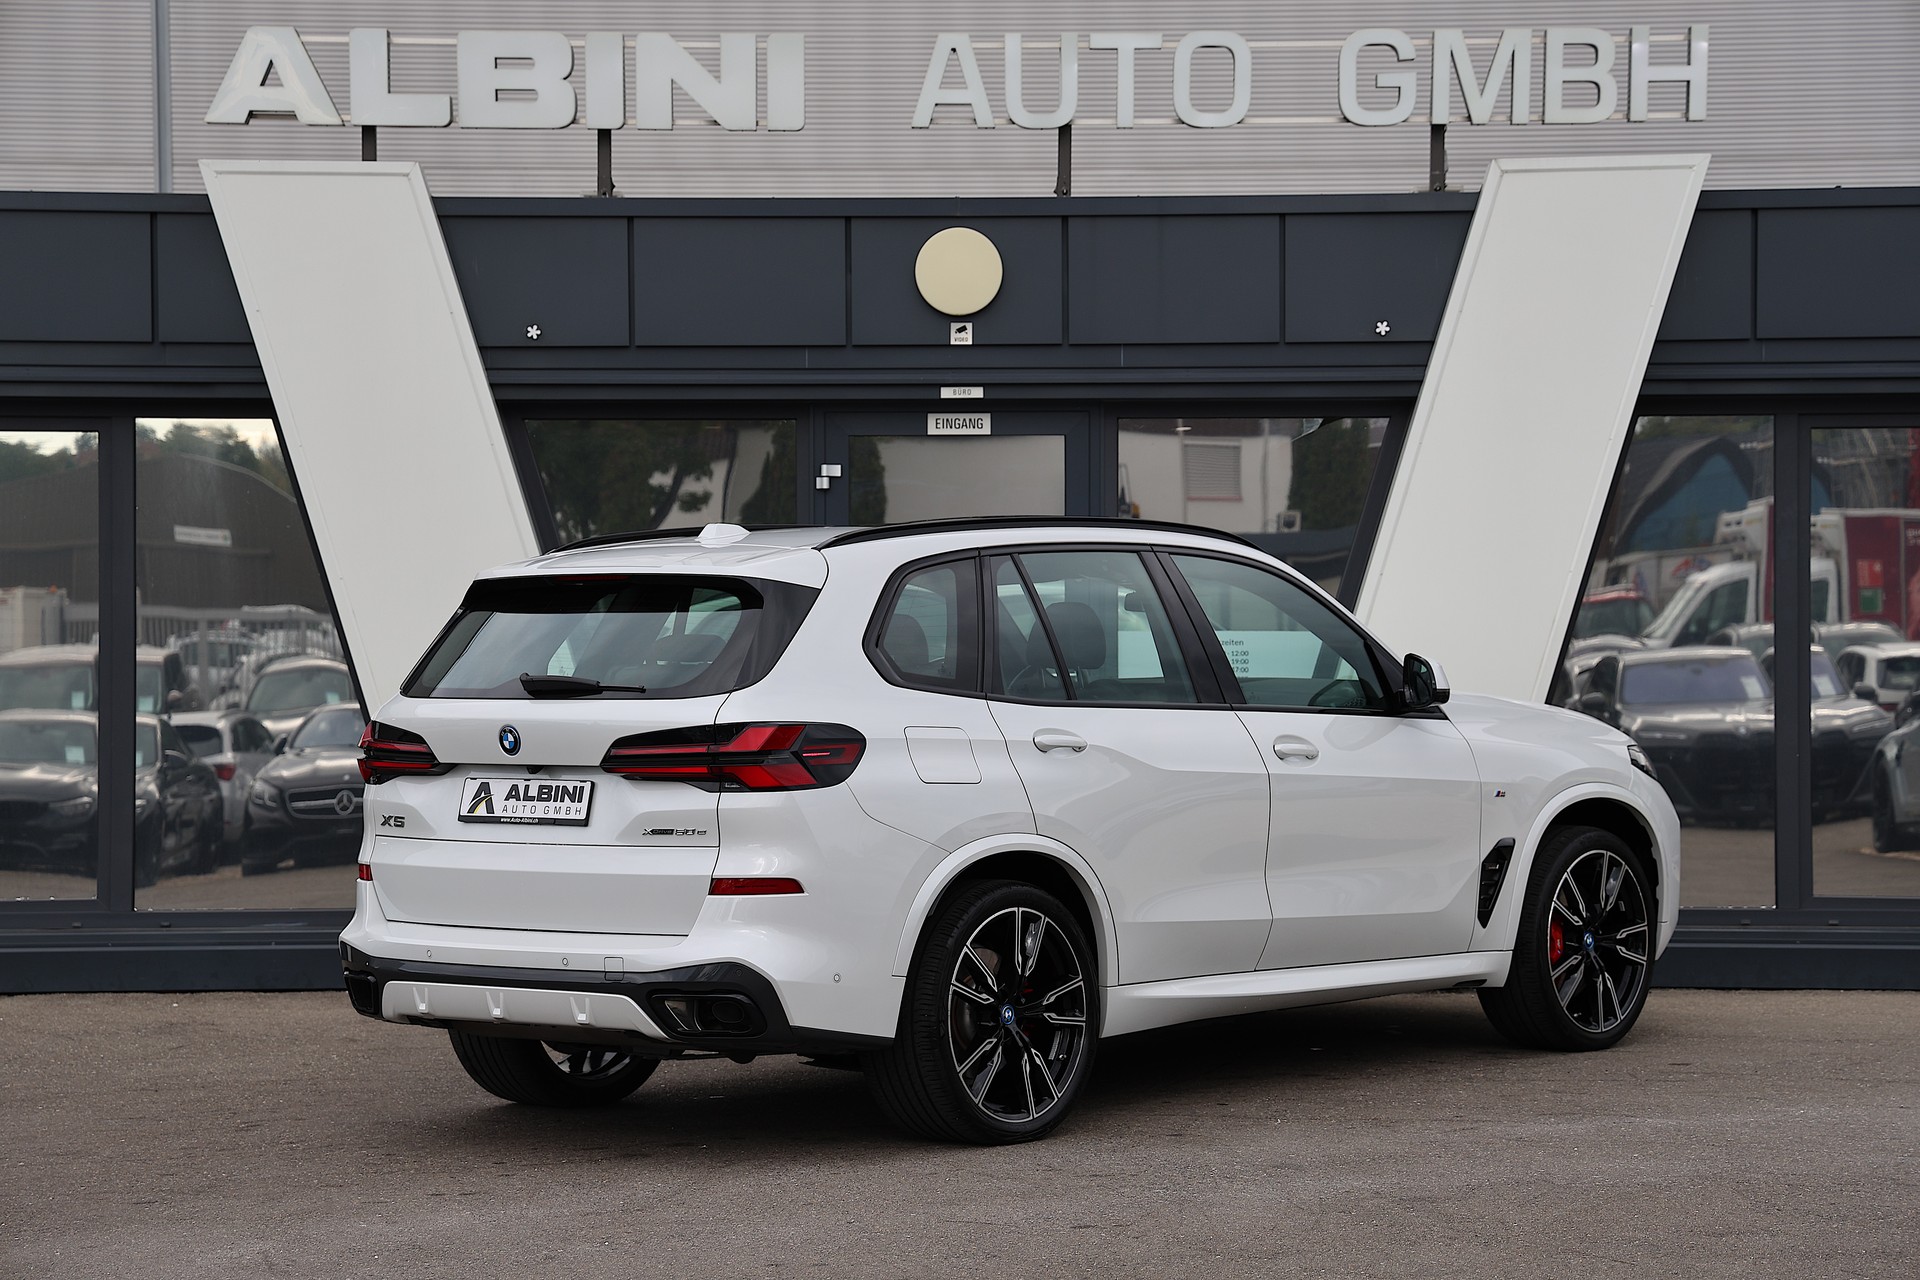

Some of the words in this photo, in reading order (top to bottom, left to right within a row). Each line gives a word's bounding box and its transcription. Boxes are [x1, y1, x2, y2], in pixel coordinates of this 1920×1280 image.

[204, 25, 806, 132] ALBINI
[911, 30, 1252, 130] AUTO
[1337, 24, 1710, 127] GMBH
[952, 387, 972, 396] BÜRO
[935, 417, 984, 430] EINGANG
[503, 783, 585, 804] ALBINI
[501, 804, 537, 815] AUTO
[542, 805, 582, 816] GMBH
[380, 814, 405, 828] X5
